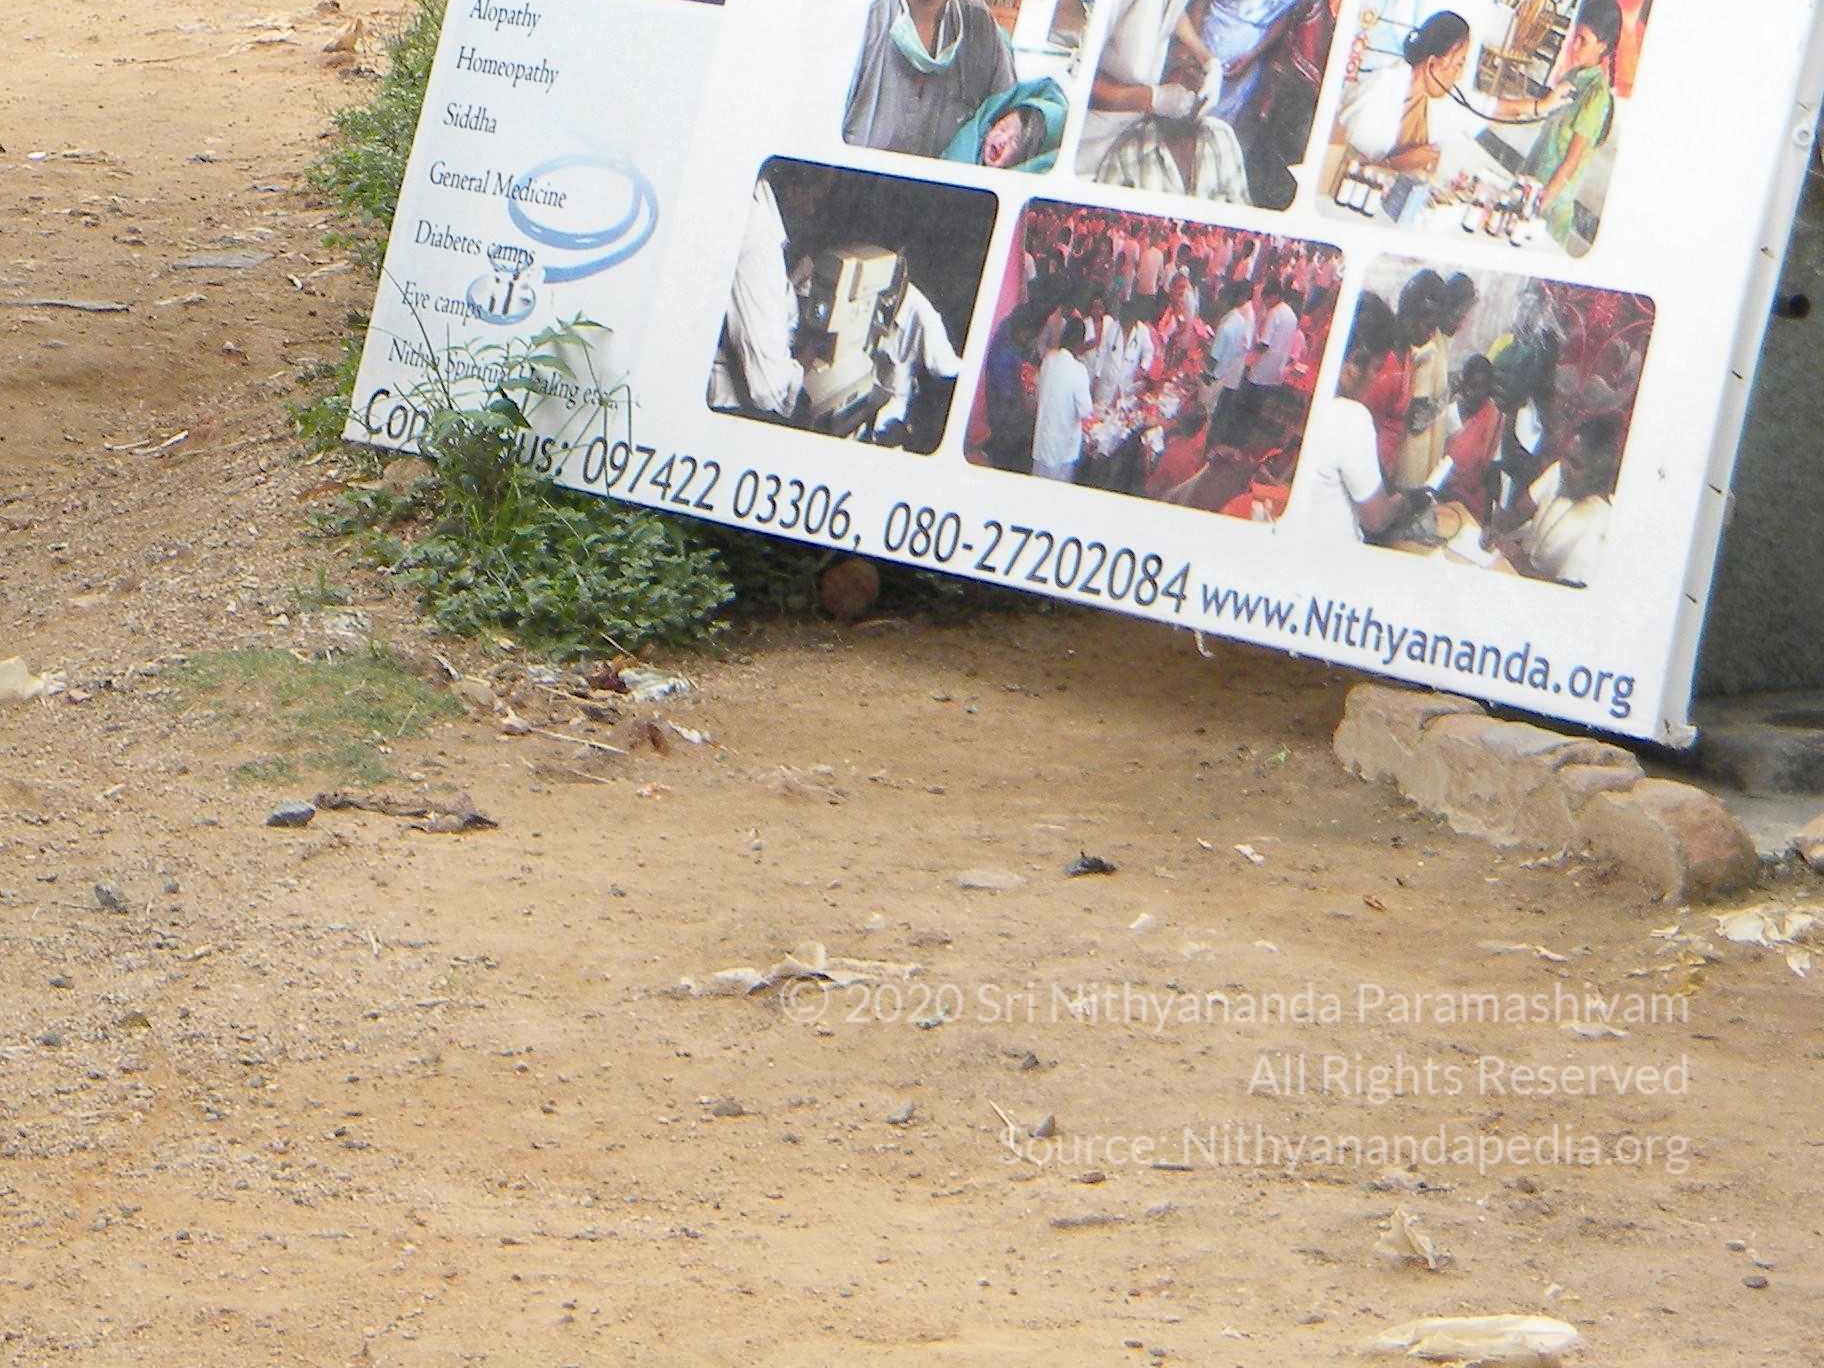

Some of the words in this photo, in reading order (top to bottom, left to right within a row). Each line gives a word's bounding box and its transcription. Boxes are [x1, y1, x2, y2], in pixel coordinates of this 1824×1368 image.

[455, 45, 559, 94] Homeopathy
[443, 102, 498, 134] Siddha
[429, 160, 490, 194] General
[492, 172, 567, 209] Medicine
[413, 219, 482, 256] Diabetes
[486, 240, 536, 269] camps
[401, 280, 430, 315] Eye
[434, 295, 483, 326] camps
[583, 435, 722, 512] 097422
[732, 469, 861, 550] 03306,
[883, 501, 1191, 614] 080-27202084
[1201, 578, 1636, 718] www.Nithyananda.org
